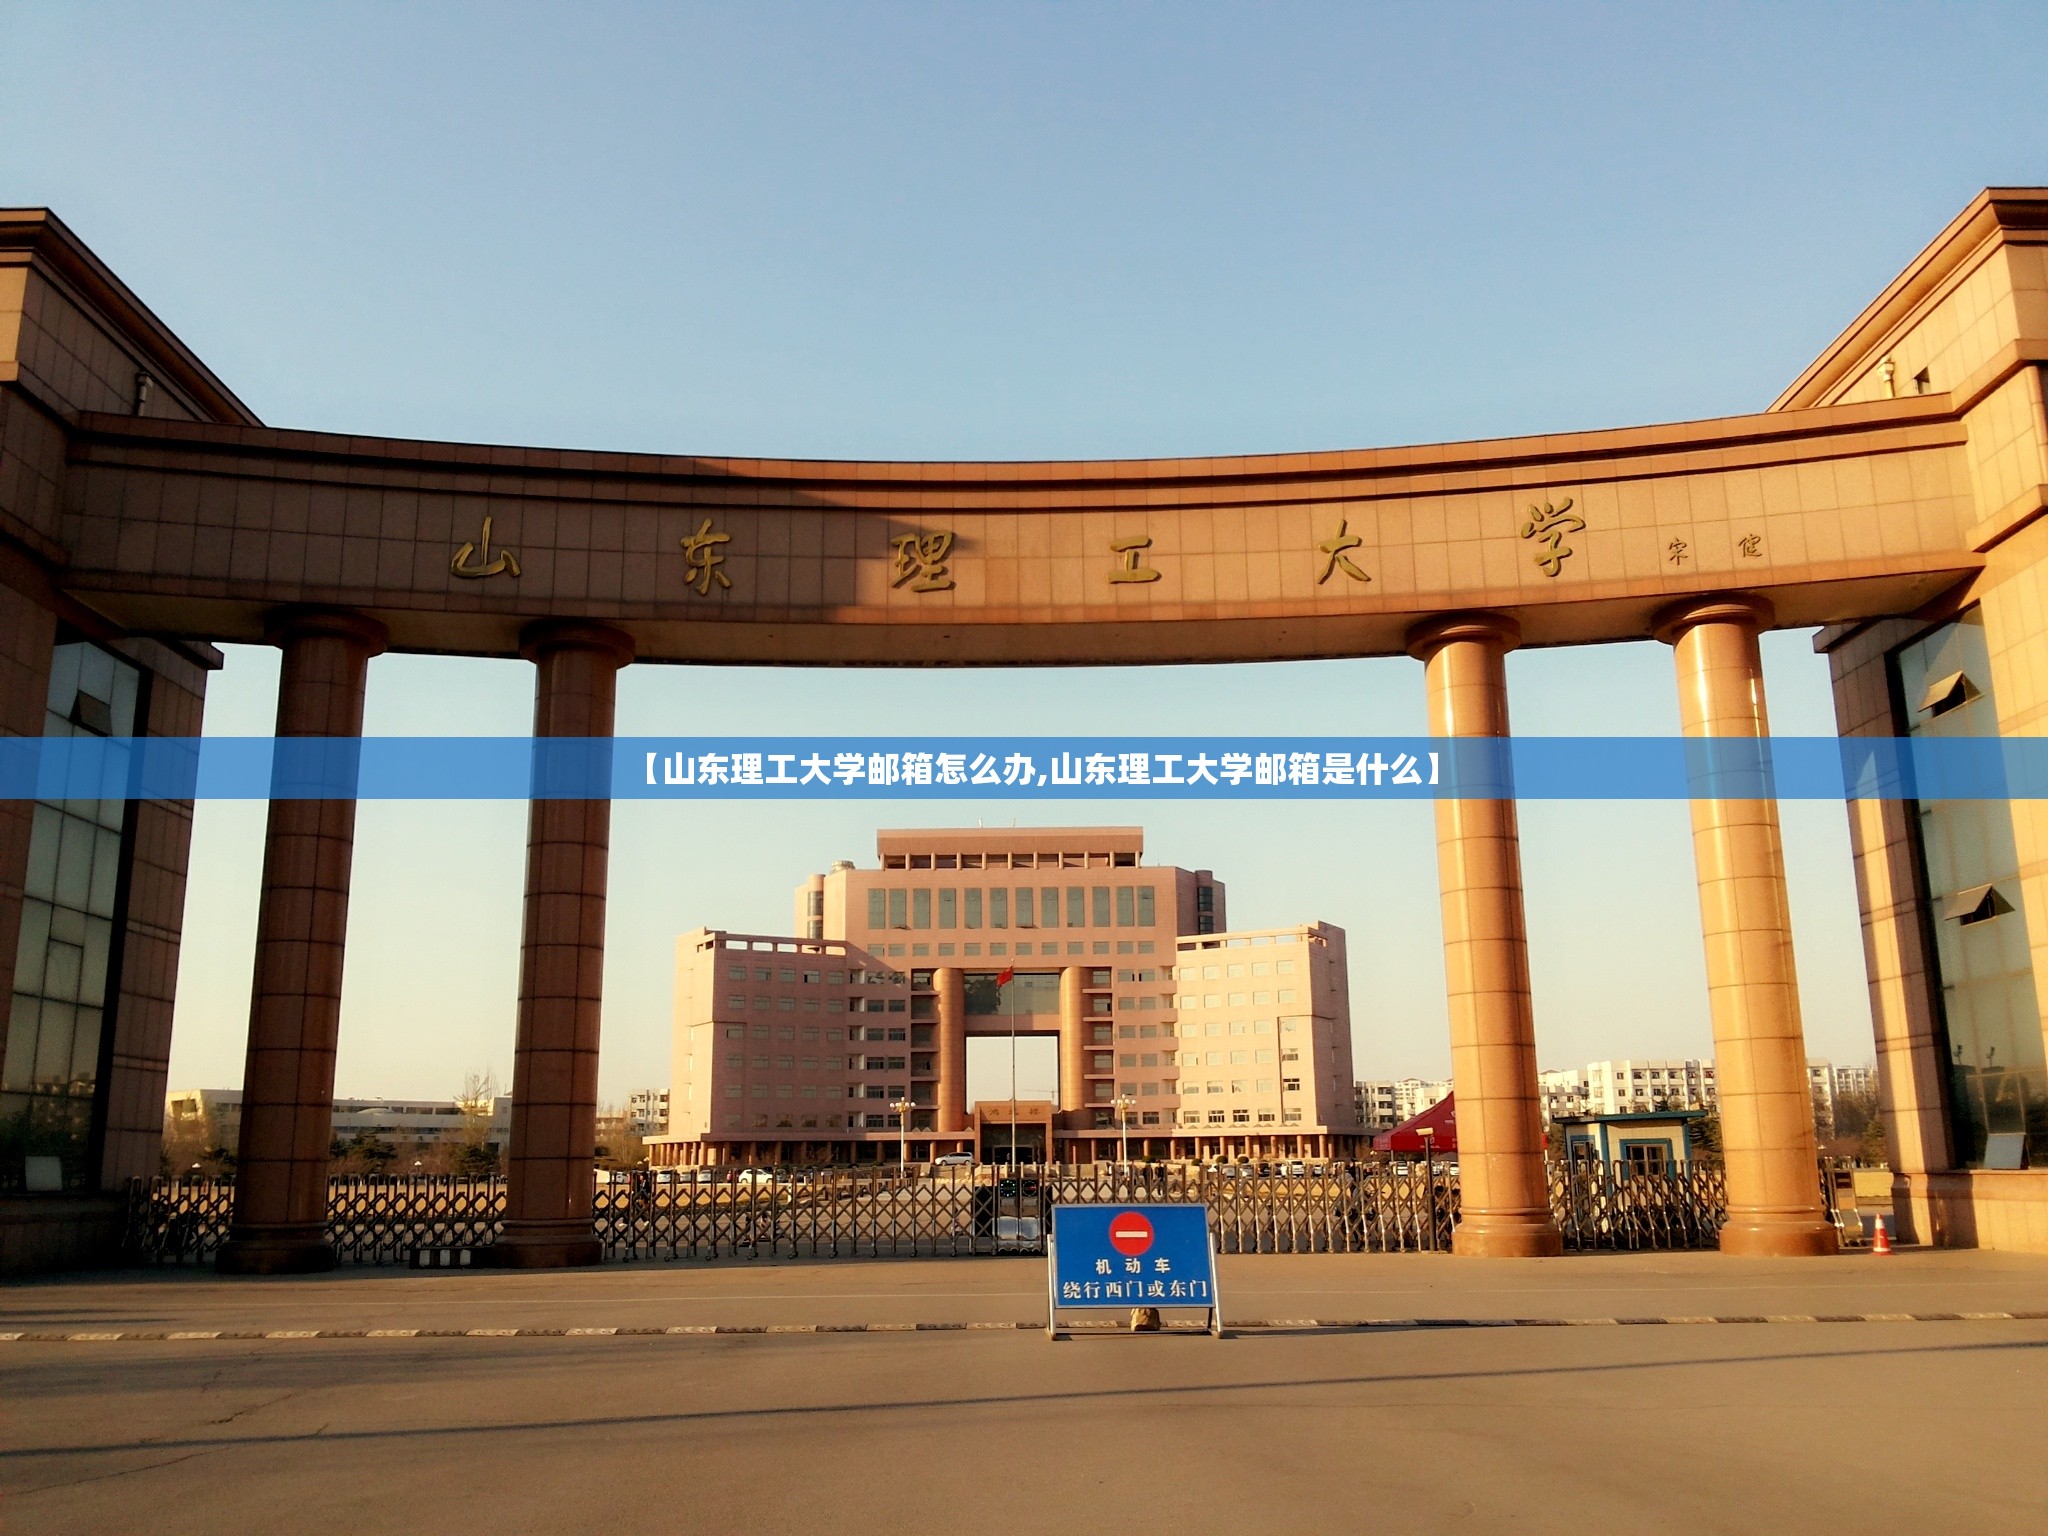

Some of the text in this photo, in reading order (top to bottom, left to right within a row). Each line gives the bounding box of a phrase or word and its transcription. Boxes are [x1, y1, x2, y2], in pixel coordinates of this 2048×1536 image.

[451, 497, 1586, 595] 山东理工大学
[1095, 1257, 1171, 1275] 机动车
[1062, 1279, 1207, 1300] 绕行西门或东门
